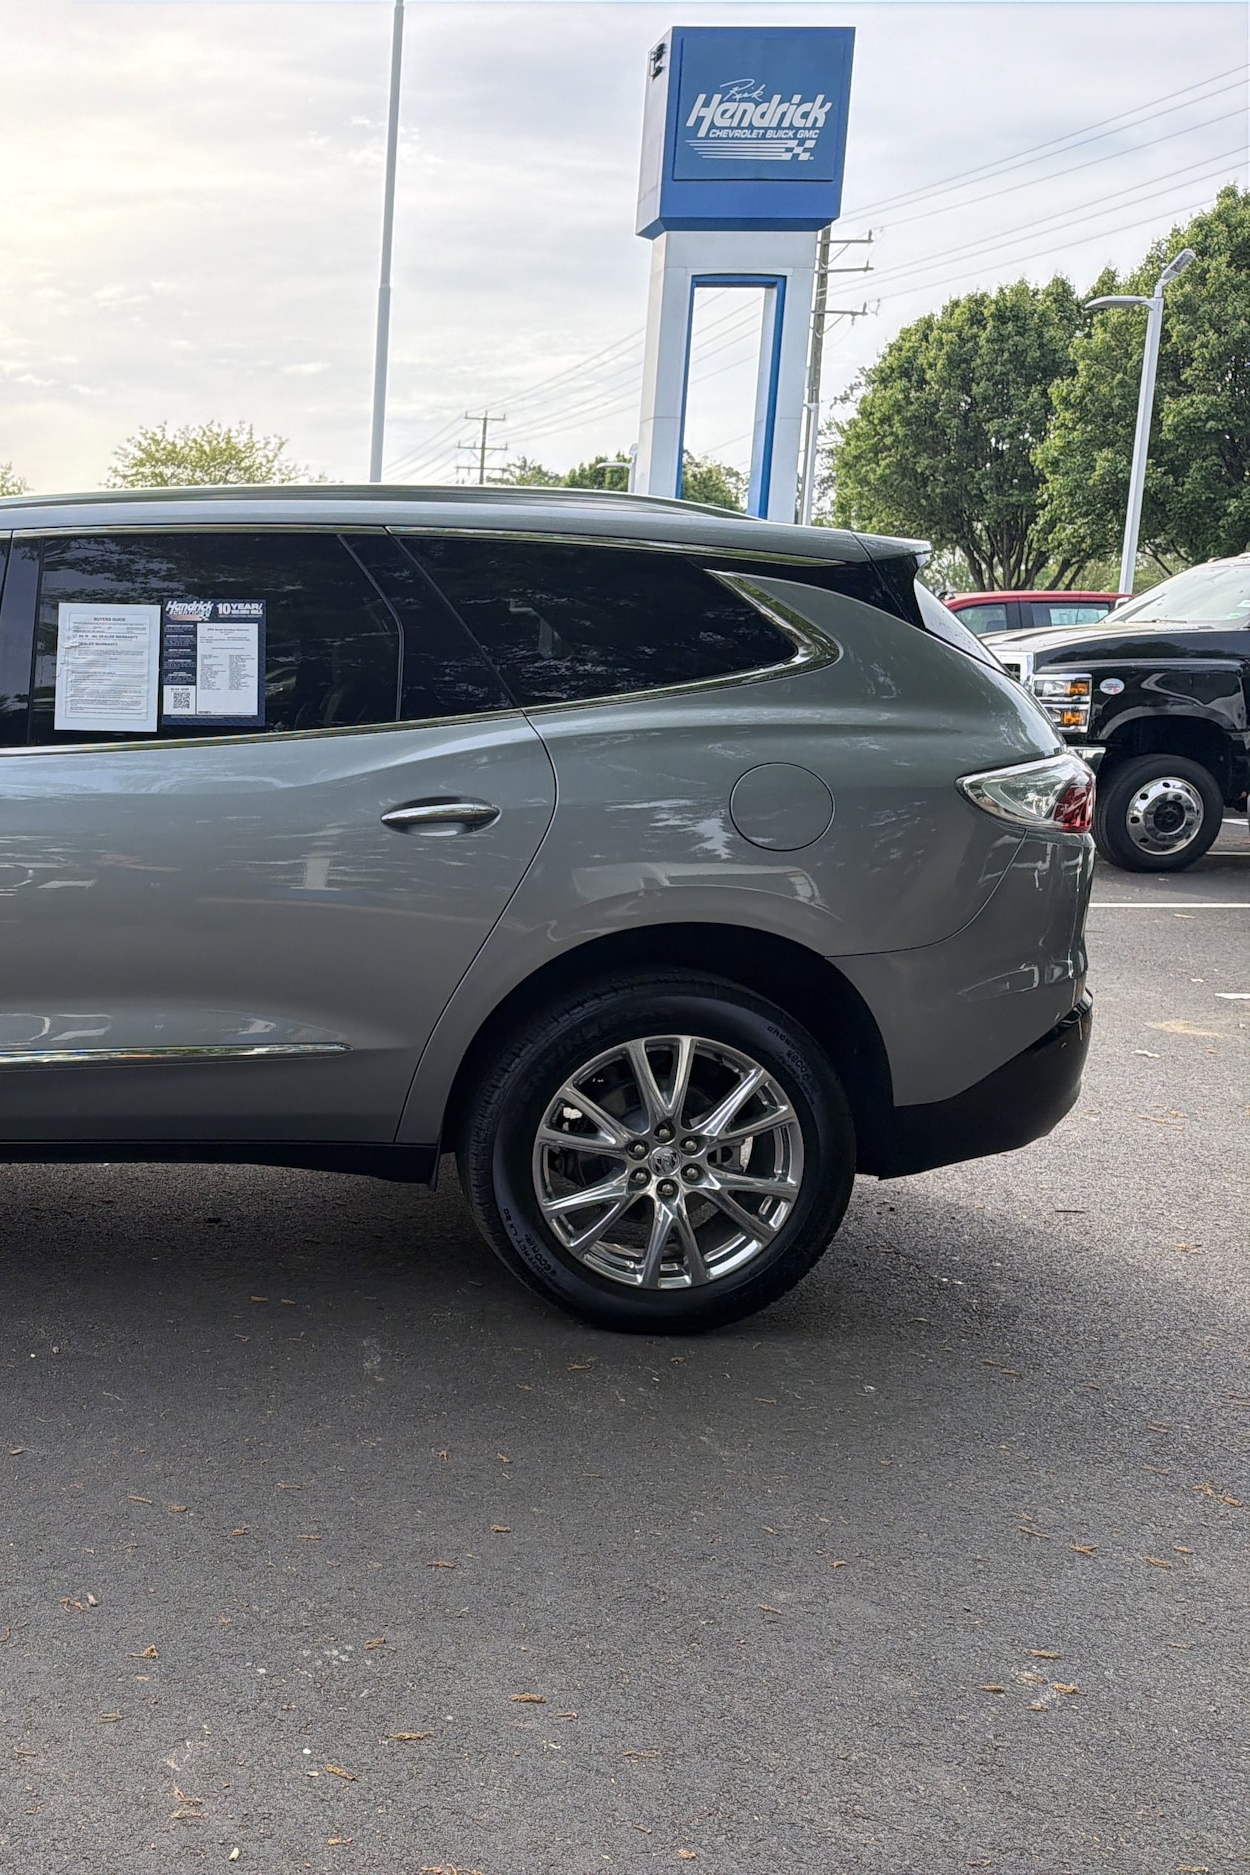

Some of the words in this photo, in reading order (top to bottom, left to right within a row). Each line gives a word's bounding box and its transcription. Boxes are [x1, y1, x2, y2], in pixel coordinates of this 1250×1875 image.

[720, 78, 768, 102] Rick
[686, 93, 833, 138] Hendrick
[709, 128, 765, 139] CHEVROLET
[766, 128, 794, 139] BUICK
[797, 129, 820, 139] GMC
[165, 600, 214, 615] Hendrick
[216, 602, 231, 615] 10
